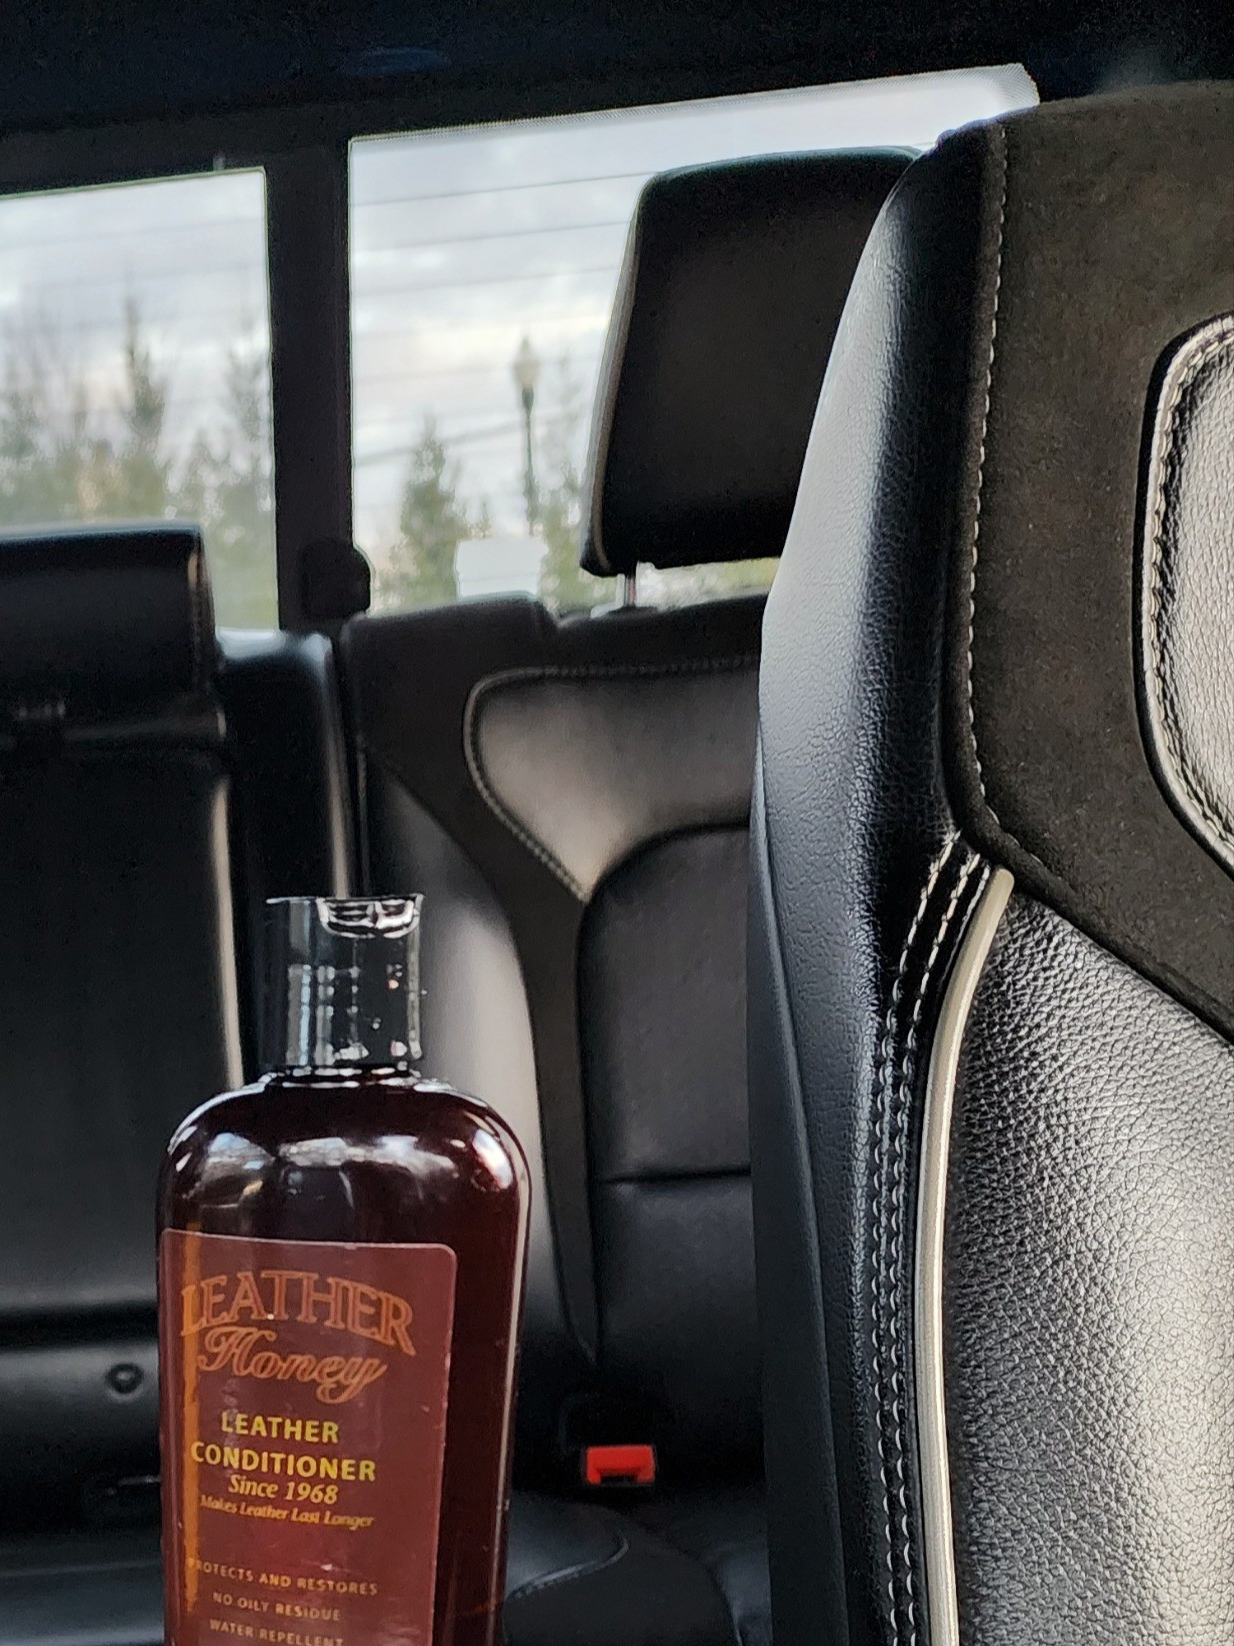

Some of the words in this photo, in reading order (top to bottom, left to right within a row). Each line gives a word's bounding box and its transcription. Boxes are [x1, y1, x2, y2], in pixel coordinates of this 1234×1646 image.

[181, 1270, 416, 1356] LEATHER
[198, 1326, 388, 1404] Honey
[221, 1411, 339, 1444] LEATHER
[190, 1441, 376, 1482] CONDITIONER
[228, 1474, 278, 1499] Since
[286, 1482, 339, 1505] 1968
[200, 1494, 238, 1514] Makes
[240, 1503, 288, 1521] Leather
[291, 1507, 319, 1523] Last
[324, 1510, 374, 1530] Longer
[187, 1557, 254, 1582] PROTECTS
[259, 1573, 291, 1588] AND
[297, 1577, 379, 1596] RESTORES
[213, 1592, 233, 1606] NO
[237, 1597, 268, 1612] OILY
[275, 1602, 341, 1622] RESIDUE
[209, 1619, 254, 1638] WATER
